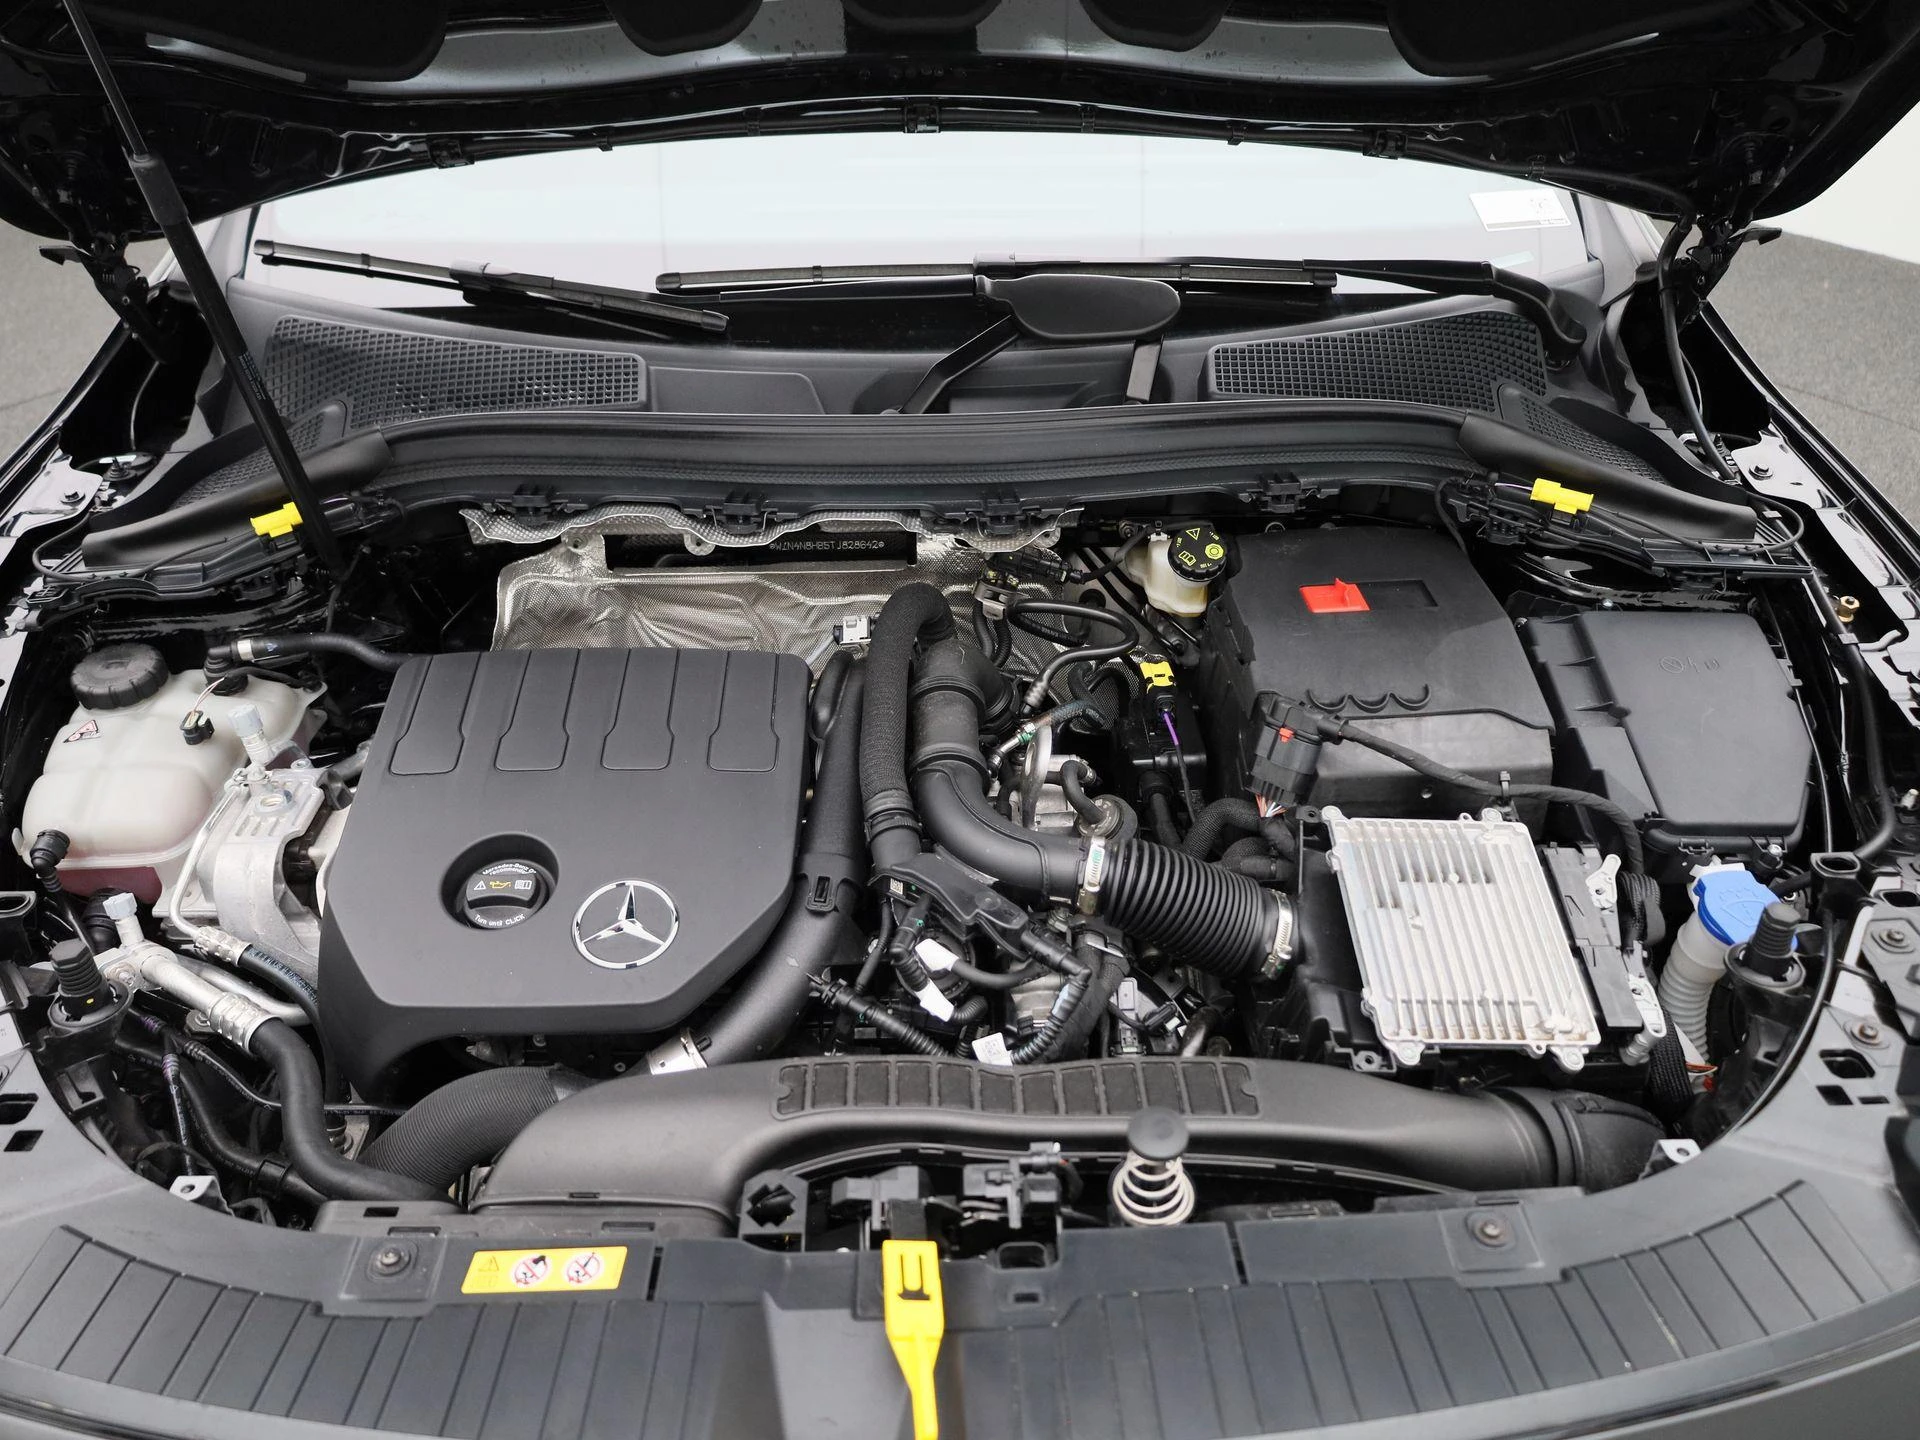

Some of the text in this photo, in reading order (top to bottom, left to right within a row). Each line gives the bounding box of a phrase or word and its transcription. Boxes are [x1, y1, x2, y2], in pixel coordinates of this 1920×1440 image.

[482, 863, 529, 875] Mercedes-Benz
[474, 914, 487, 925] Turn
[505, 913, 526, 925] CLICK
